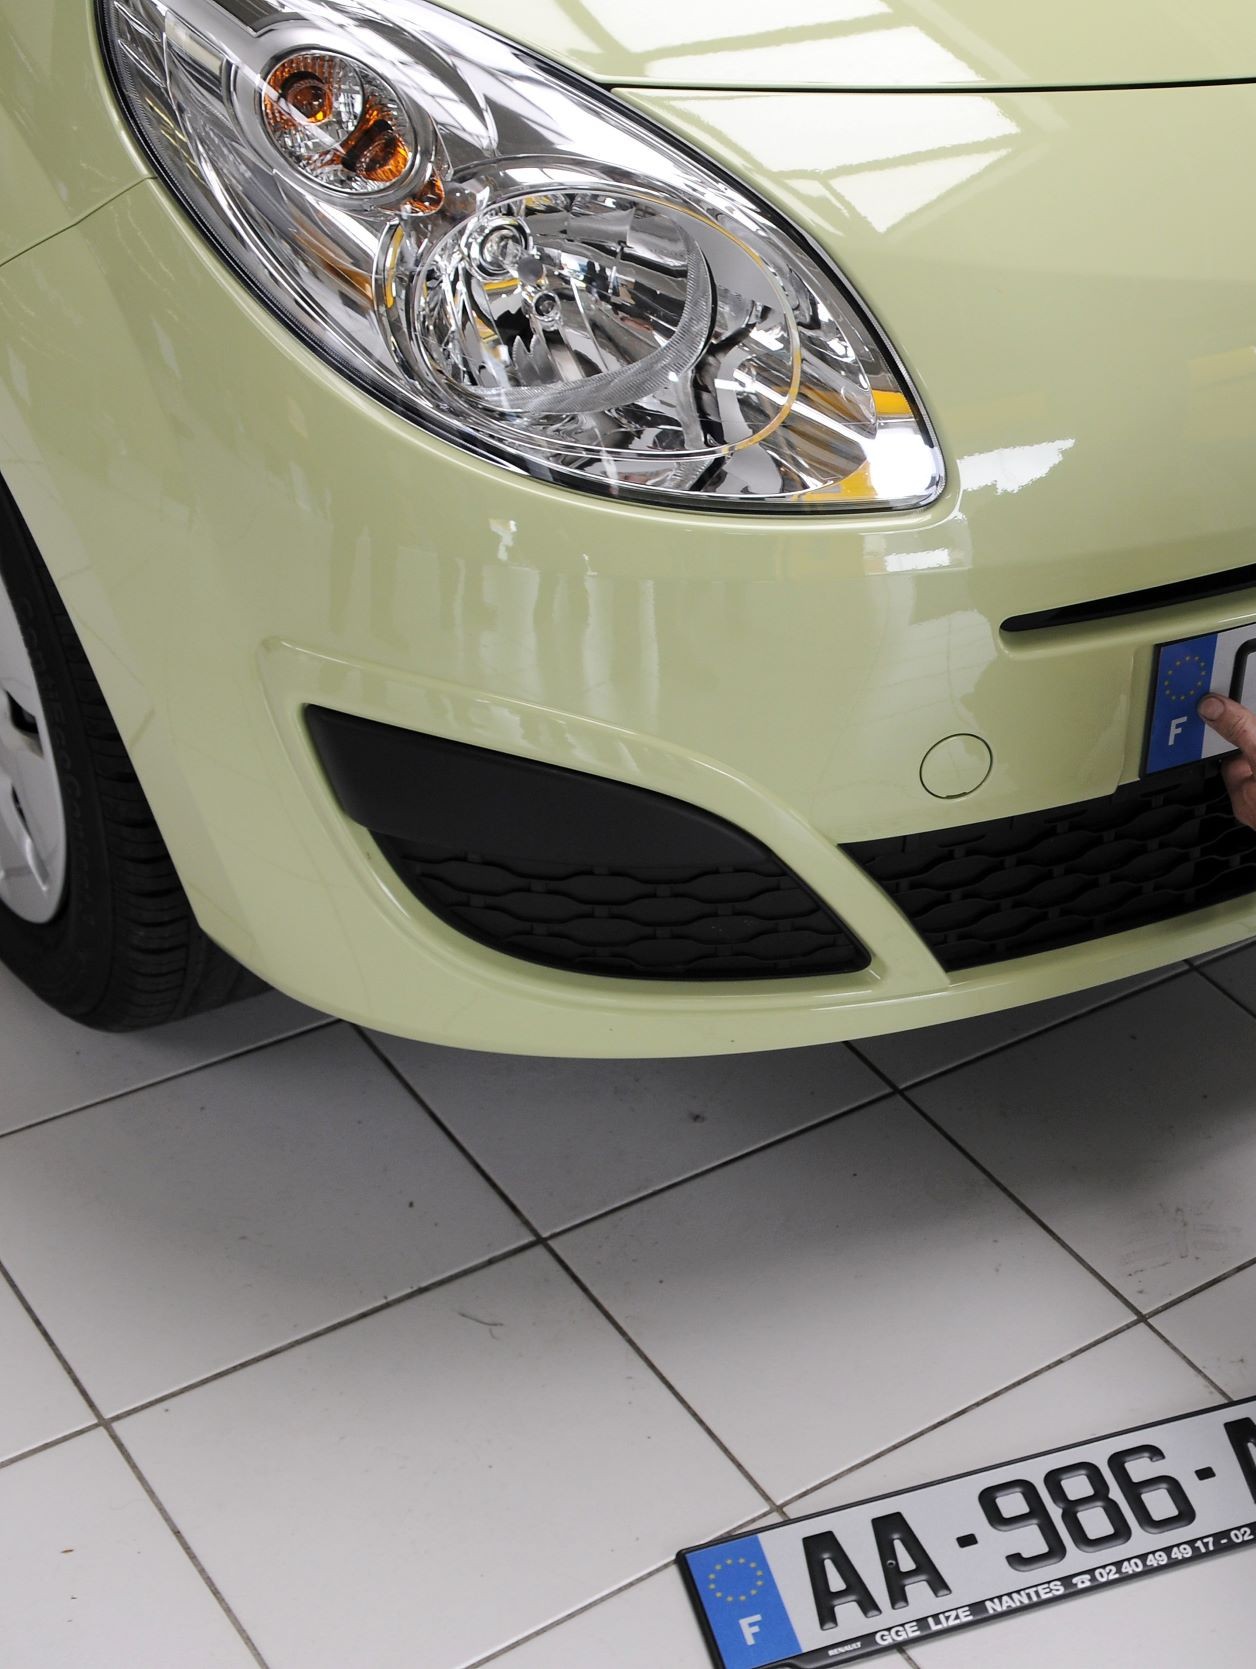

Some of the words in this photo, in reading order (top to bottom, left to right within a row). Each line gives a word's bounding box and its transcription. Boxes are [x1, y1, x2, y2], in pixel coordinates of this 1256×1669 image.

[1168, 715, 1188, 746] F
[875, 1621, 921, 1646] GGE
[927, 1606, 973, 1631] LIZE
[985, 1580, 1065, 1615] NANTES
[1095, 1565, 1120, 1582] 02
[1121, 1557, 1144, 1574] 40
[1146, 1550, 1168, 1567] 49
[1171, 1543, 1193, 1559] 49
[1195, 1536, 1215, 1553] 17
[1230, 1526, 1254, 1543] 02
[739, 1614, 763, 1646] F
